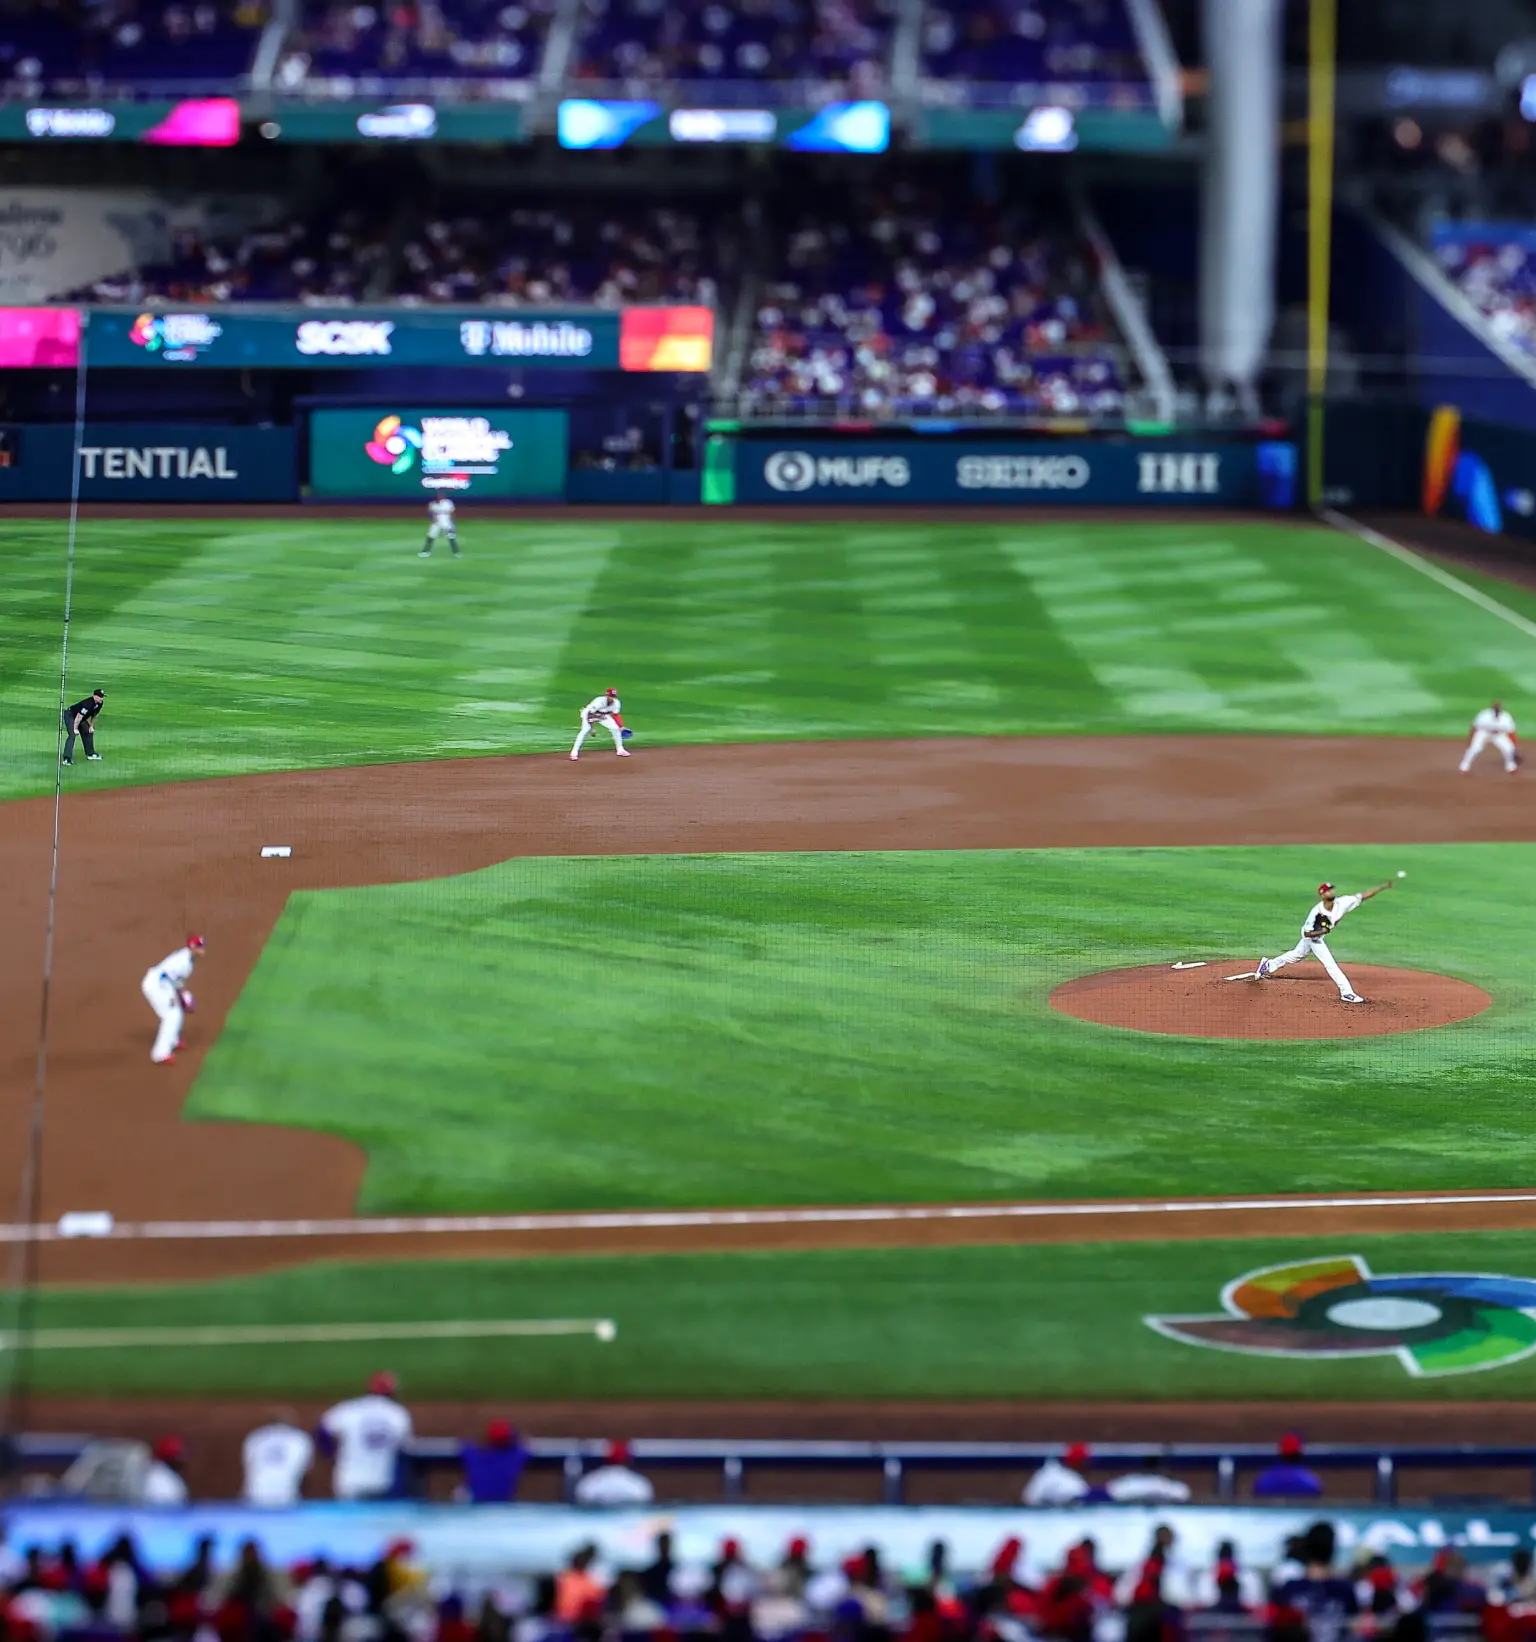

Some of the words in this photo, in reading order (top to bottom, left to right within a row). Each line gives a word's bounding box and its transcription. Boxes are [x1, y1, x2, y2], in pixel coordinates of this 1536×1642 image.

[77, 447, 238, 478] TENTIAL
[818, 456, 911, 487] MUFG
[956, 455, 1090, 489] SEIKO
